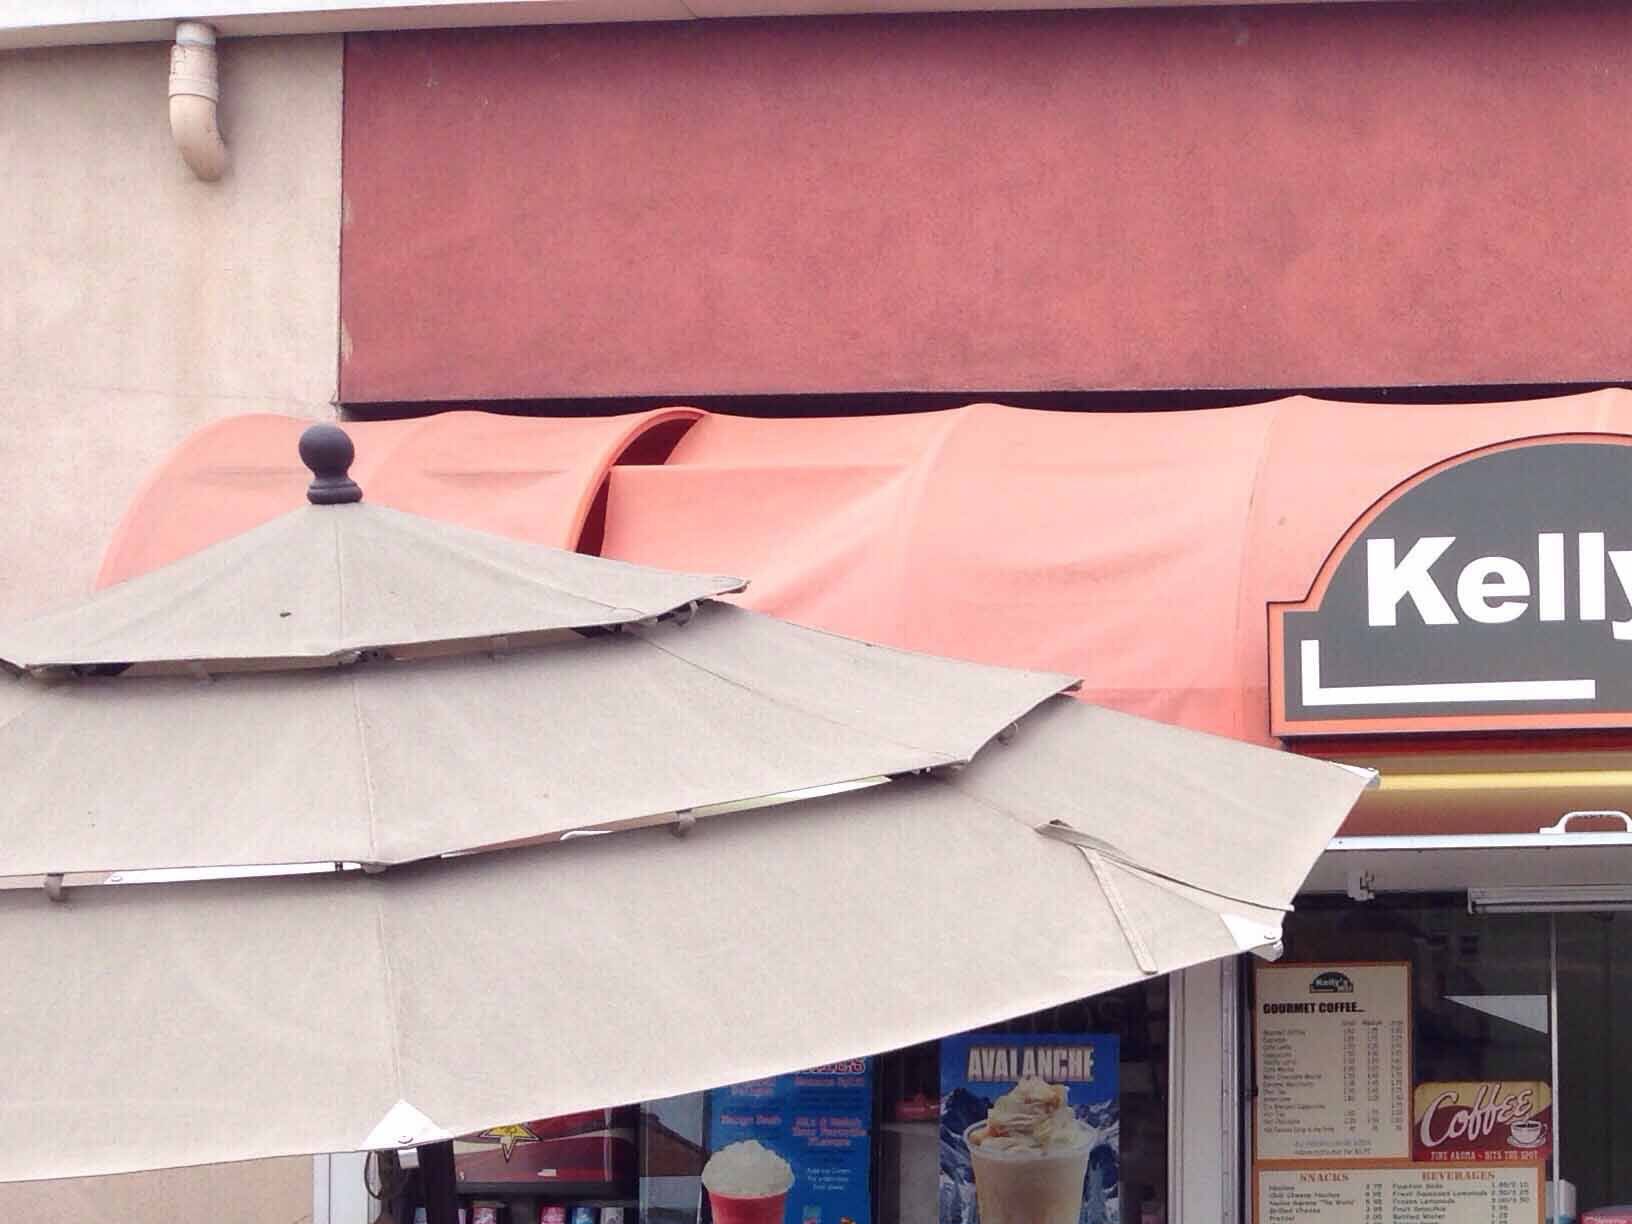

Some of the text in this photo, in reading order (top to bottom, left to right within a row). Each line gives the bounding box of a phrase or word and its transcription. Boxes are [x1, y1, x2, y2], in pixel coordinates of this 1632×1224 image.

[1263, 1003, 1316, 1014] GOURMET
[968, 1046, 1094, 1083] AVALANCHE
[1300, 1172, 1349, 1183] SNACKS
[1421, 1170, 1495, 1182] BEVERAGES
